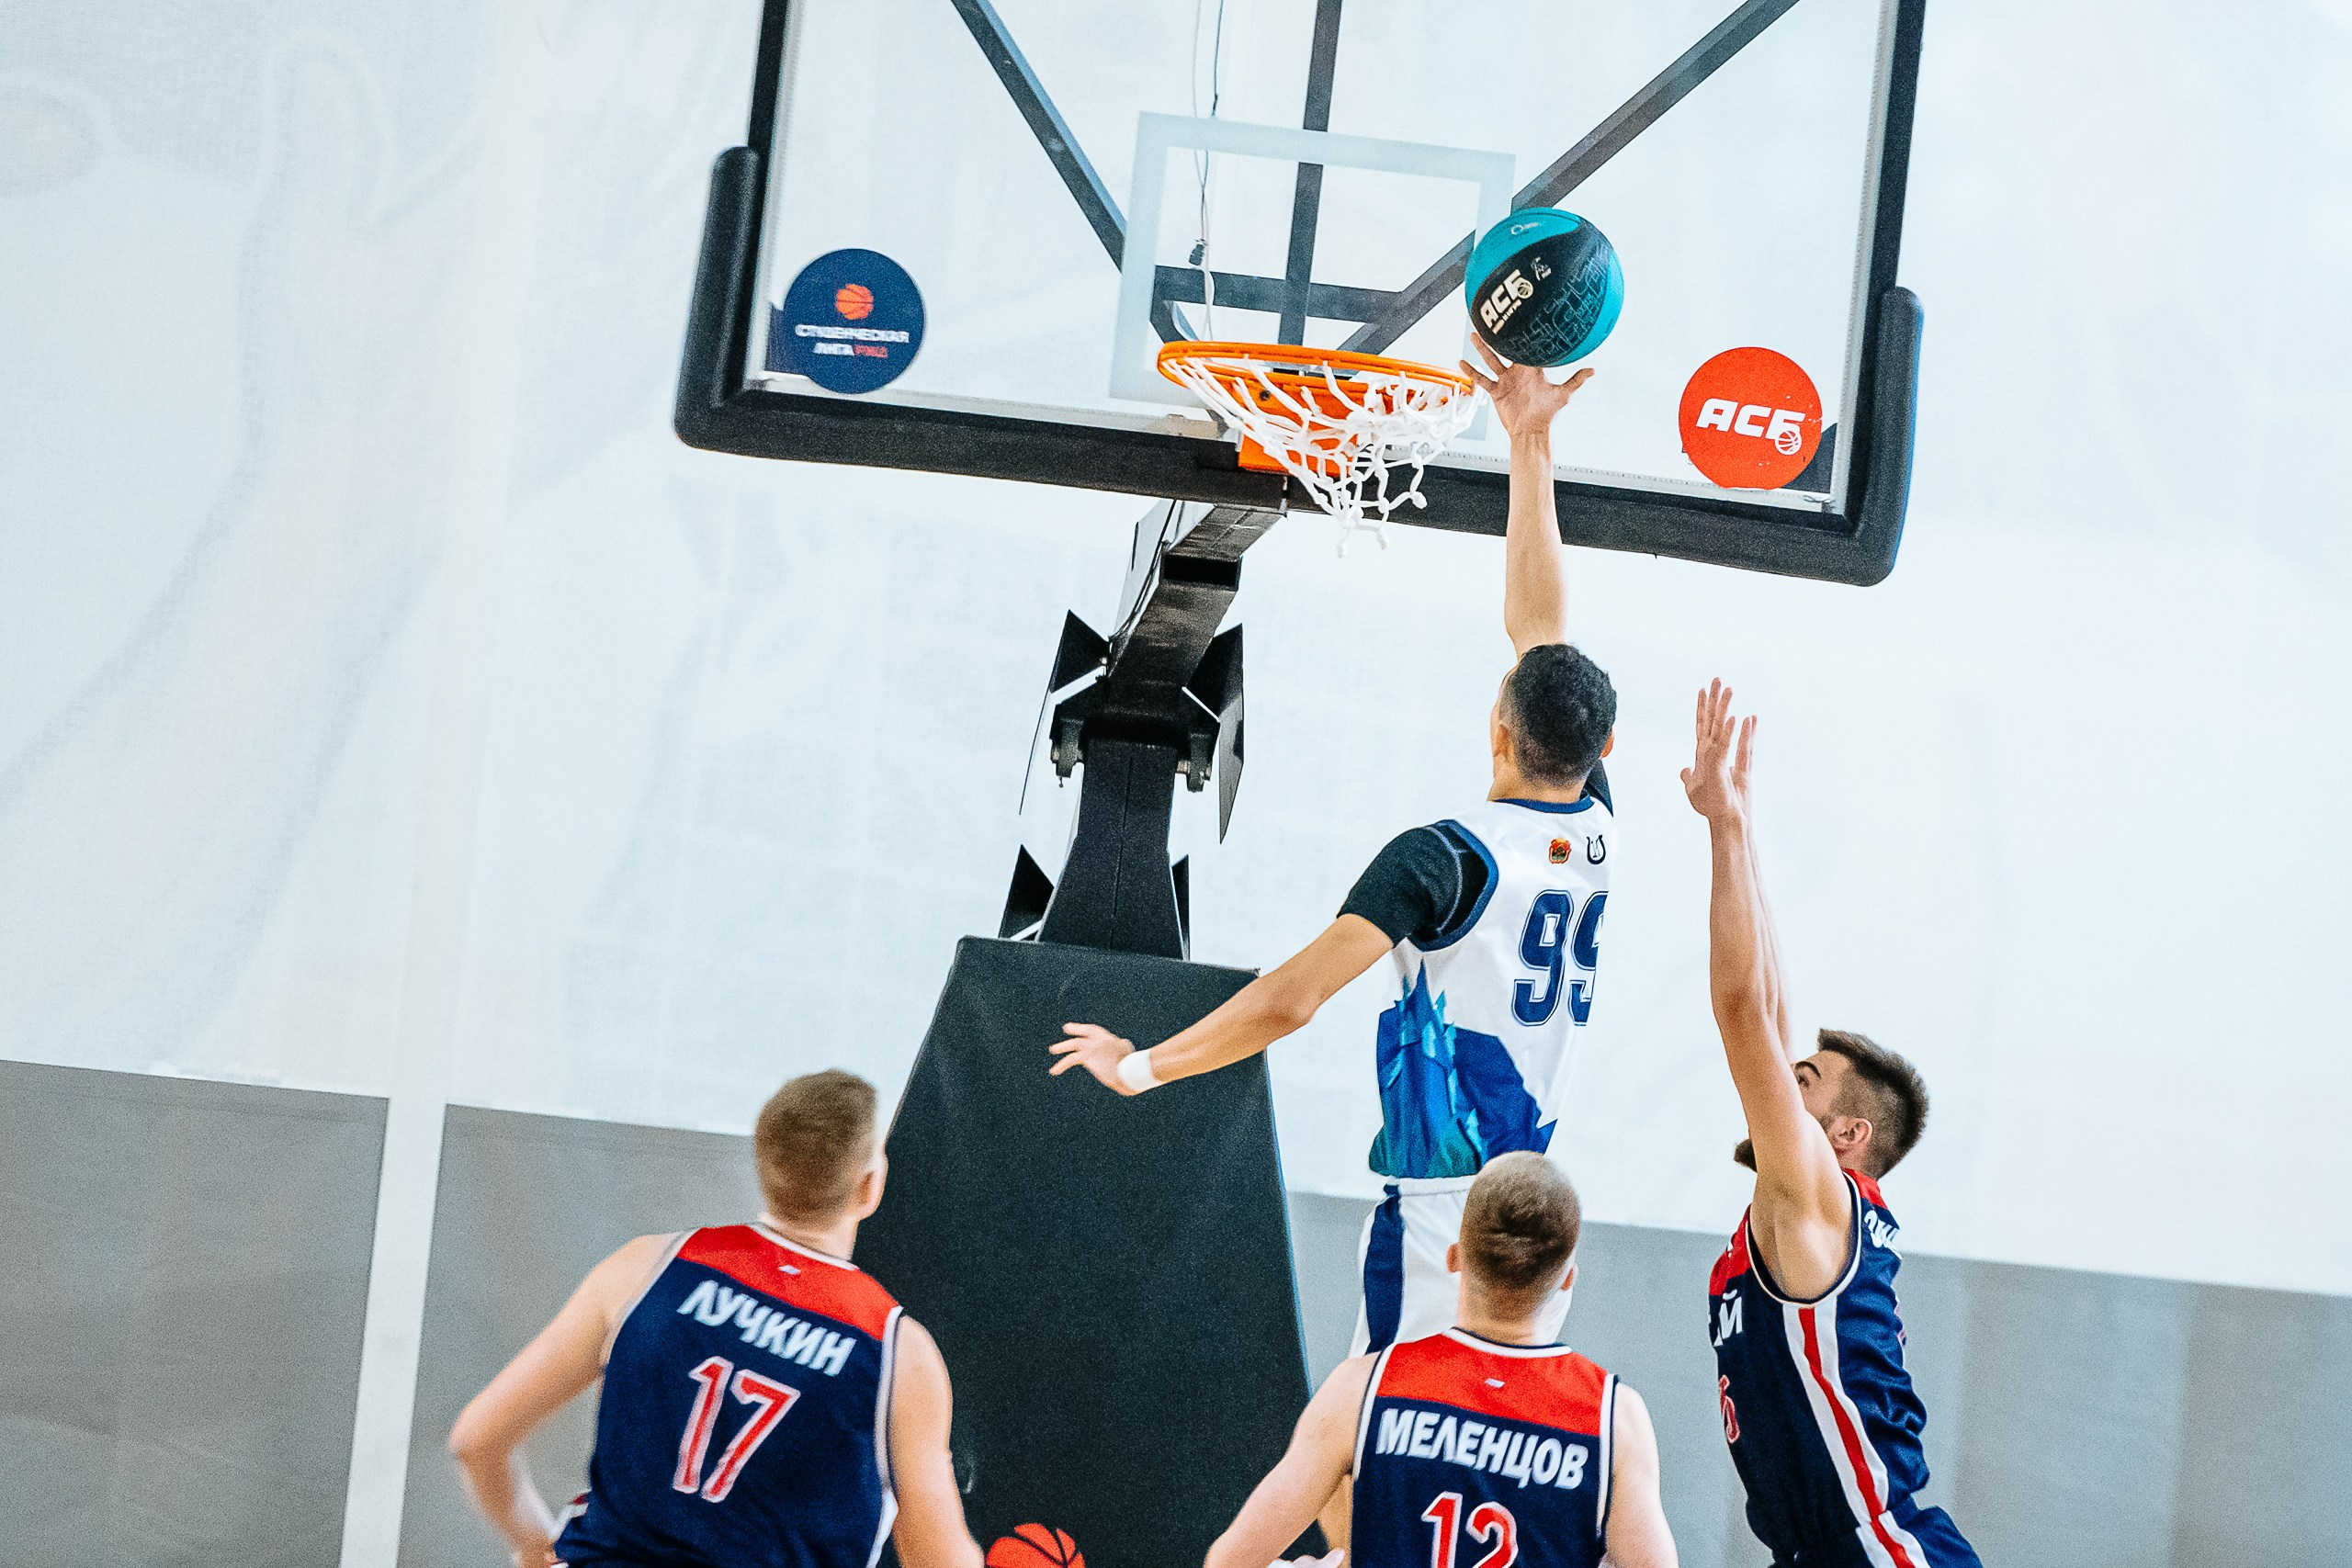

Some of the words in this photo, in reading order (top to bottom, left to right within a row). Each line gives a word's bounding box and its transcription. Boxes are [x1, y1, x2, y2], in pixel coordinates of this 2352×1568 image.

[1480, 269, 1533, 328] АСБ
[1696, 398, 1806, 456] АСБ
[1511, 889, 1609, 1026] 99
[676, 1280, 857, 1376] ЛУЧКИН
[672, 1356, 801, 1504] 17
[1375, 1407, 1589, 1490] МЕЛЕНЦОВ
[1421, 1491, 1520, 1568] 12
